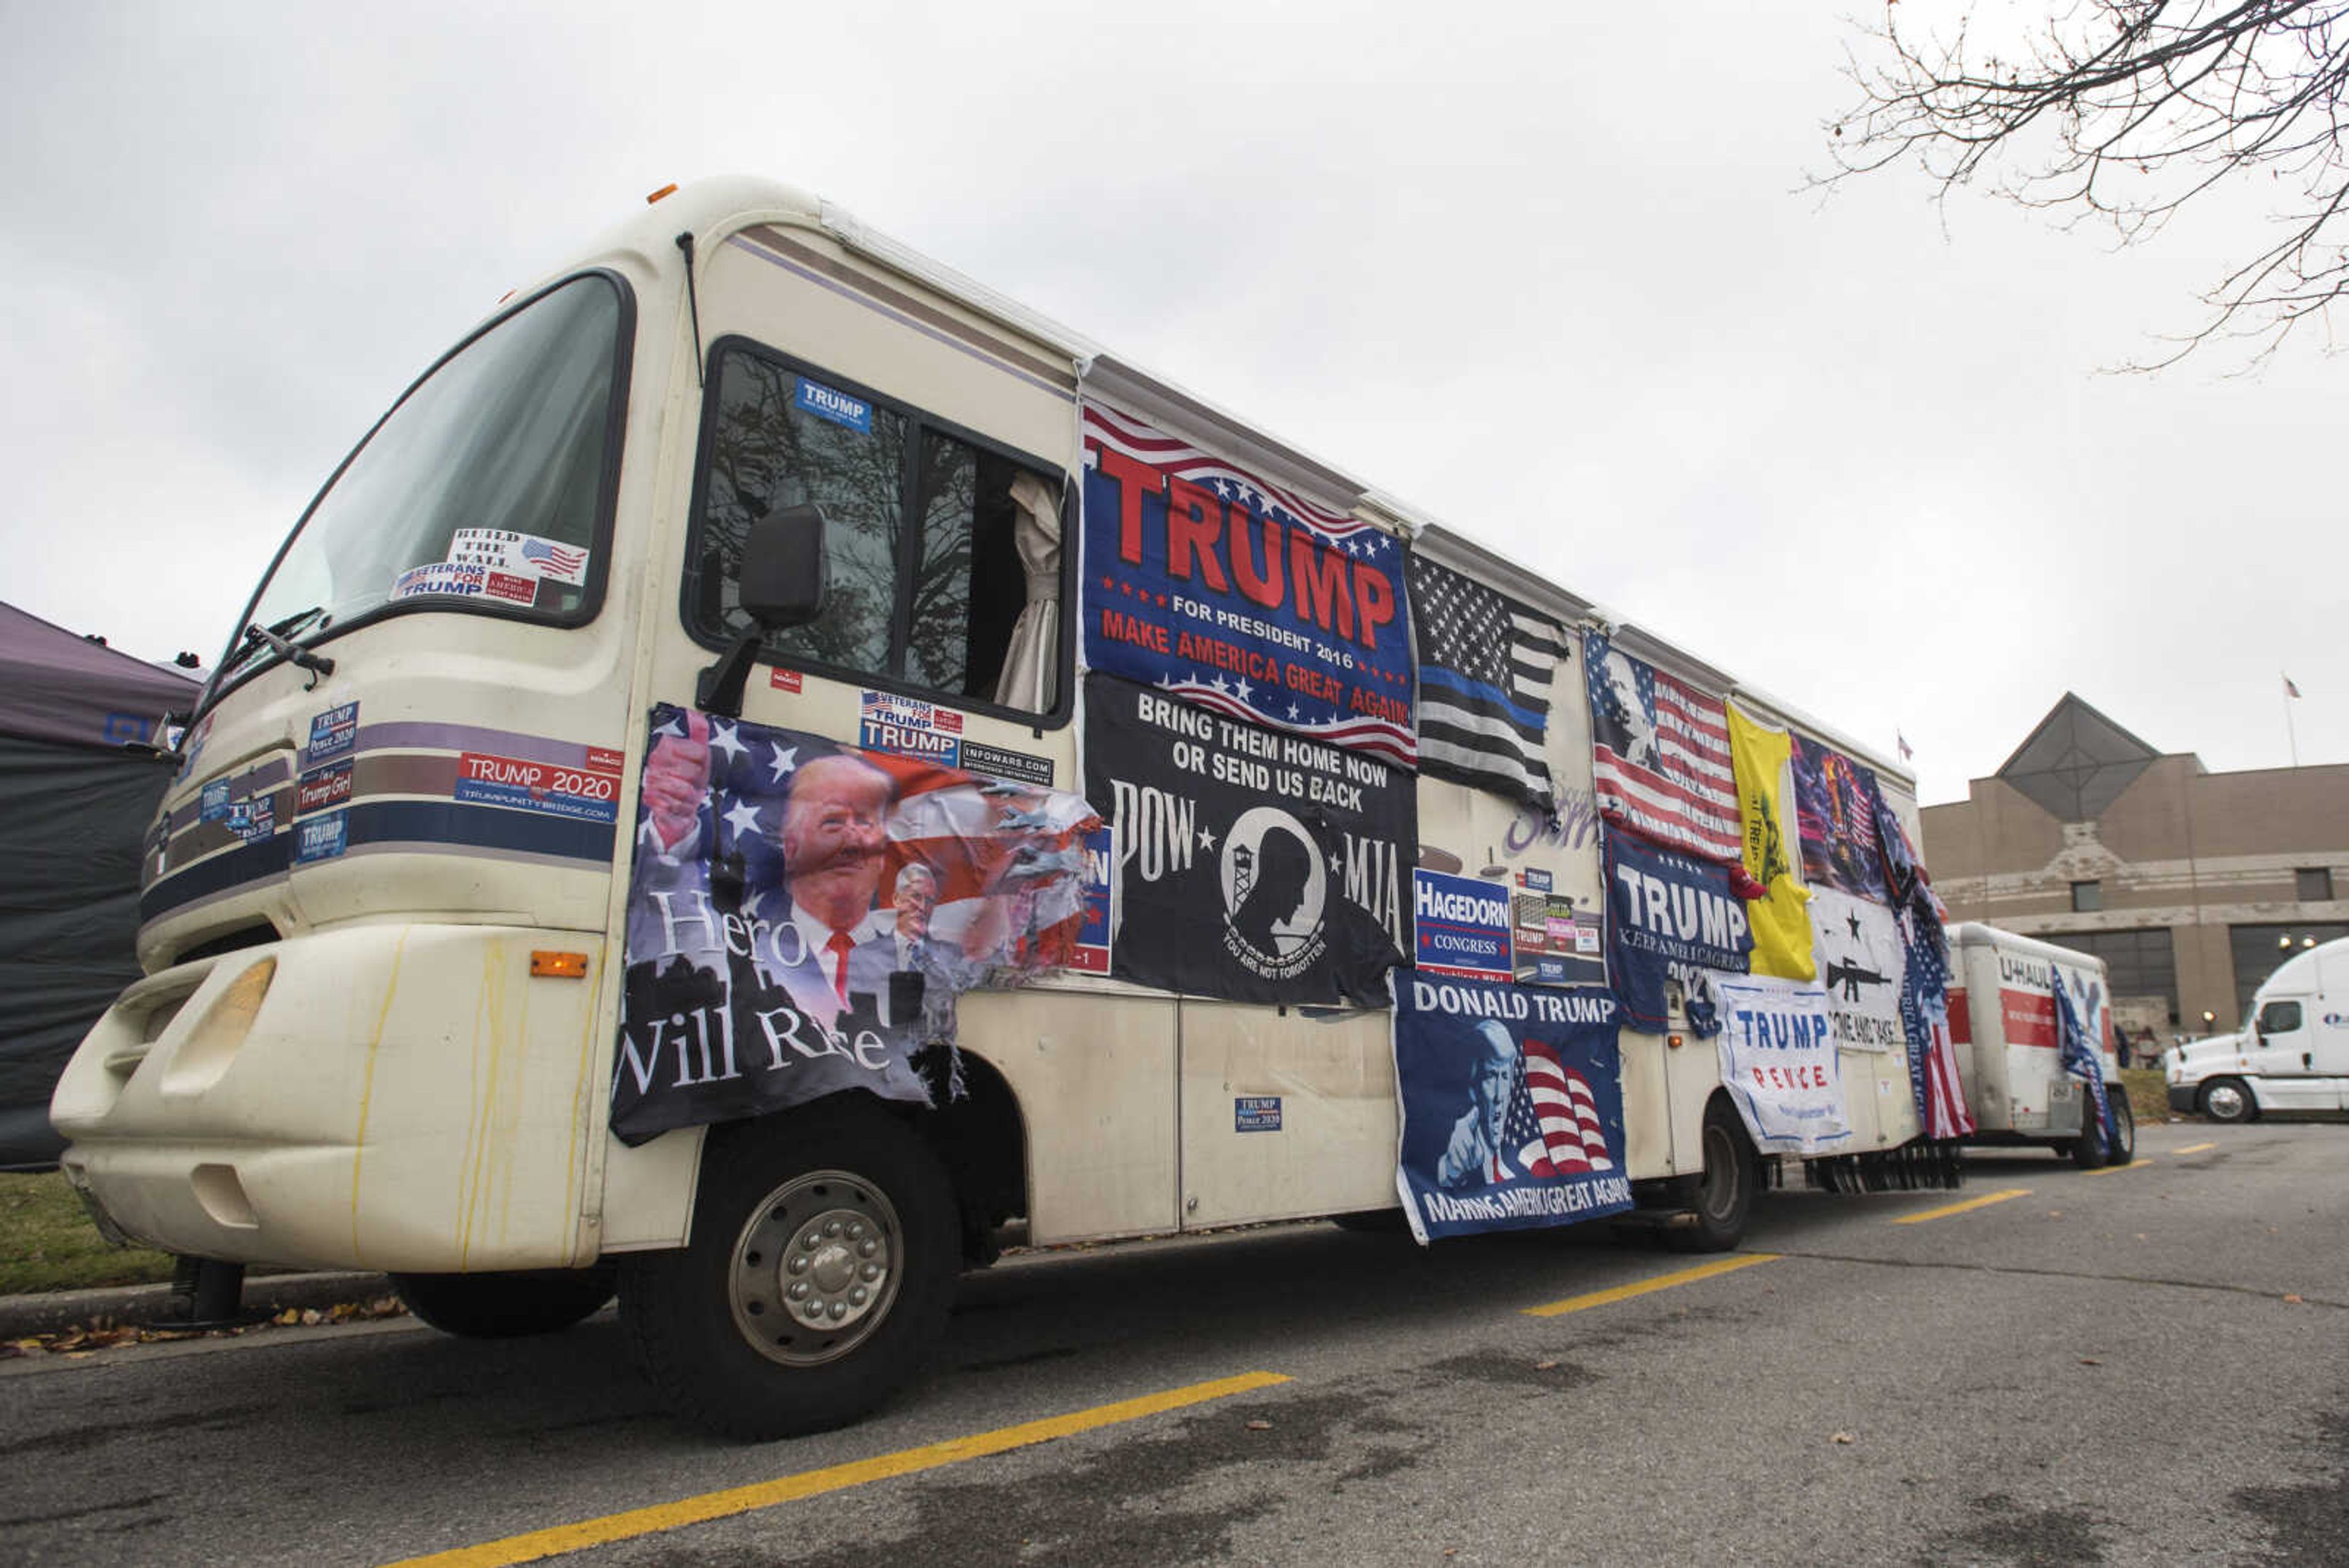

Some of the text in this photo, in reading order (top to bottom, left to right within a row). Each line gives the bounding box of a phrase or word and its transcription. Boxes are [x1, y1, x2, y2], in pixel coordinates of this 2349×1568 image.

[804, 384, 864, 417] TRUMP
[1099, 444, 1395, 650] TRUMP
[403, 581, 483, 595] TRUMP
[454, 573, 483, 584] FOR
[1173, 595, 1354, 669] FOR PRESIDENT 2016
[1103, 609, 1170, 653] MAKE
[1178, 631, 1280, 685] AMERICA
[1286, 663, 1343, 706] GREAT
[317, 705, 353, 729] TRUMP
[875, 709, 931, 729] TRUMP
[881, 693, 932, 710] VETERANS
[864, 720, 955, 752] TRUMP
[1138, 693, 1387, 788] BRING THEM HOME NOW
[965, 748, 1048, 773] INFOWARS.COM
[1173, 741, 1362, 812] OR SEND US BACK
[302, 775, 351, 804] Trump Girl
[468, 759, 541, 786] TRUMP
[552, 771, 612, 800] 2020
[303, 822, 343, 847] TRUMP
[1110, 778, 1197, 943] POW
[1343, 832, 1405, 961] MIA
[1417, 881, 1509, 928] HAGEDORN
[1617, 863, 1746, 951] TRUMP
[649, 890, 807, 967] Hero
[1434, 935, 1497, 954] CONGRESS
[1515, 929, 1544, 944] TRUMP
[1620, 928, 1656, 951] KEEP
[1224, 932, 1326, 979] YOU ARE NOT FORGOTTEN
[1540, 963, 1562, 975] TRUMP
[1413, 981, 1616, 1024] DONALD TRUMP
[1736, 1011, 1827, 1049] TRUMP
[1752, 1066, 1827, 1089] PENCE
[1424, 1192, 1506, 1223] MAKING
[1548, 1183, 1593, 1214] GREAT
